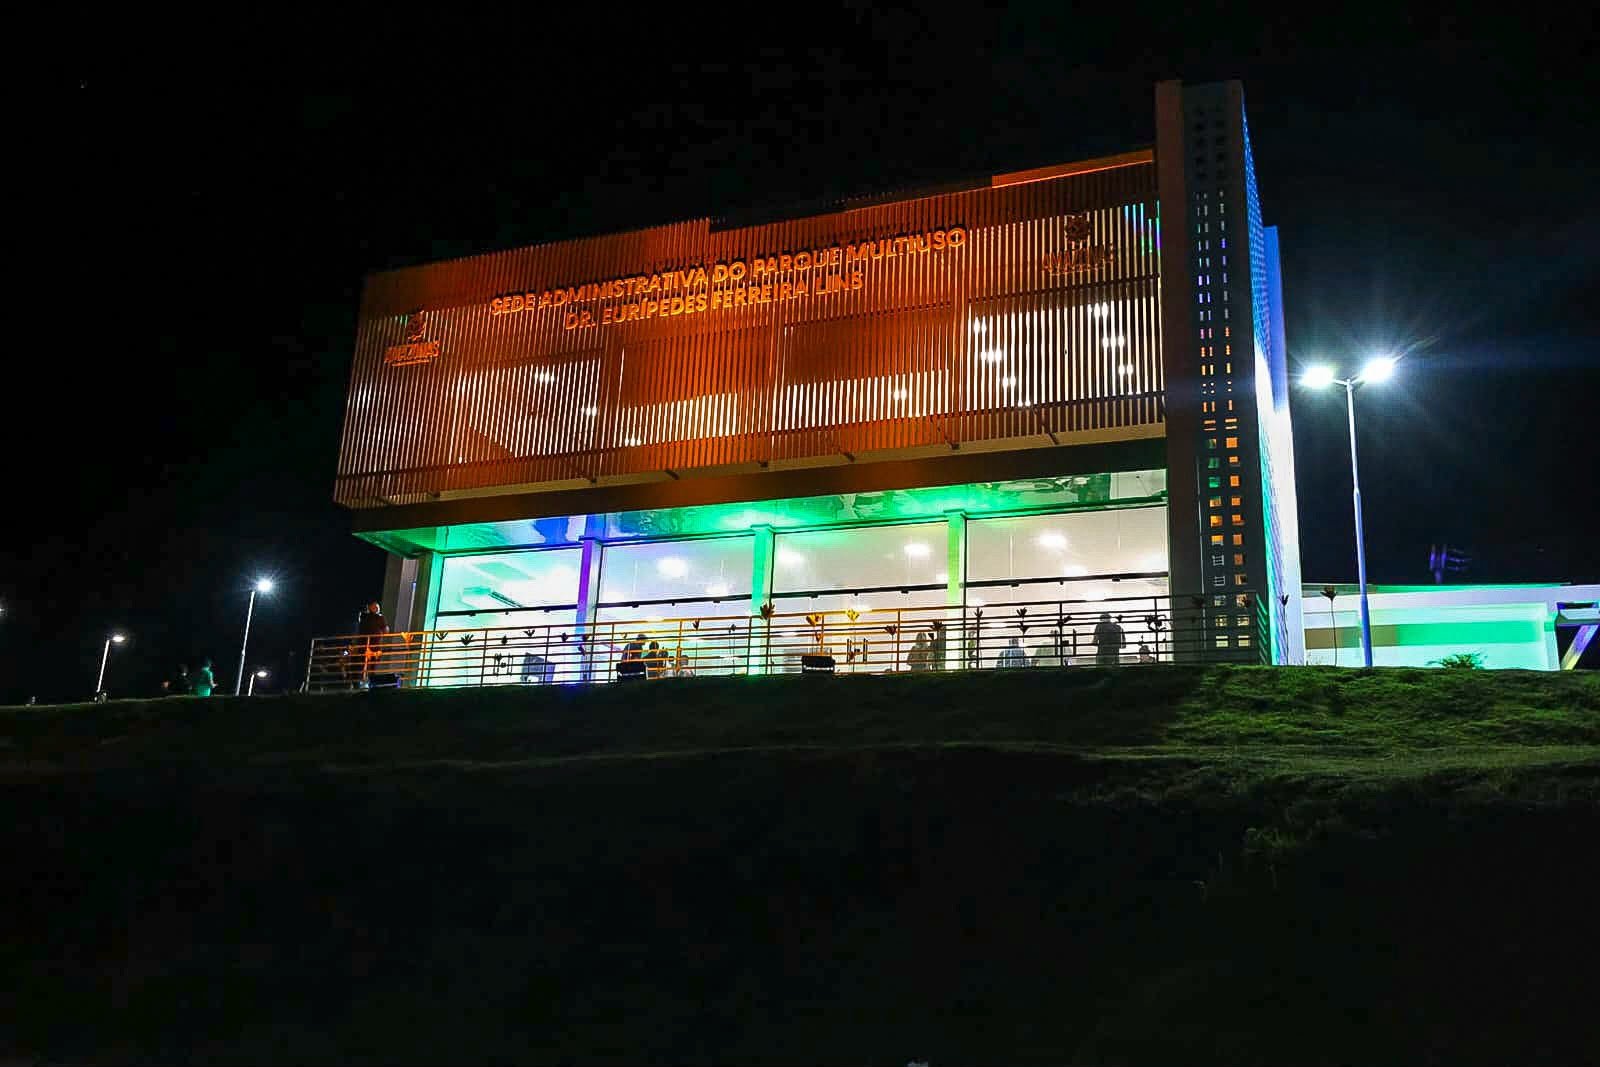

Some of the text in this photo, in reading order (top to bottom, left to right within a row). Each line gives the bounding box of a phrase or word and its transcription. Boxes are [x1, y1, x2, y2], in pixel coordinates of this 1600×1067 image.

[491, 227, 967, 315] SEDE ADMINISTRATIVA DO PARQUE MULTIUSO
[566, 271, 864, 330] DR. EURÍPEDES FERREIRA LINS
